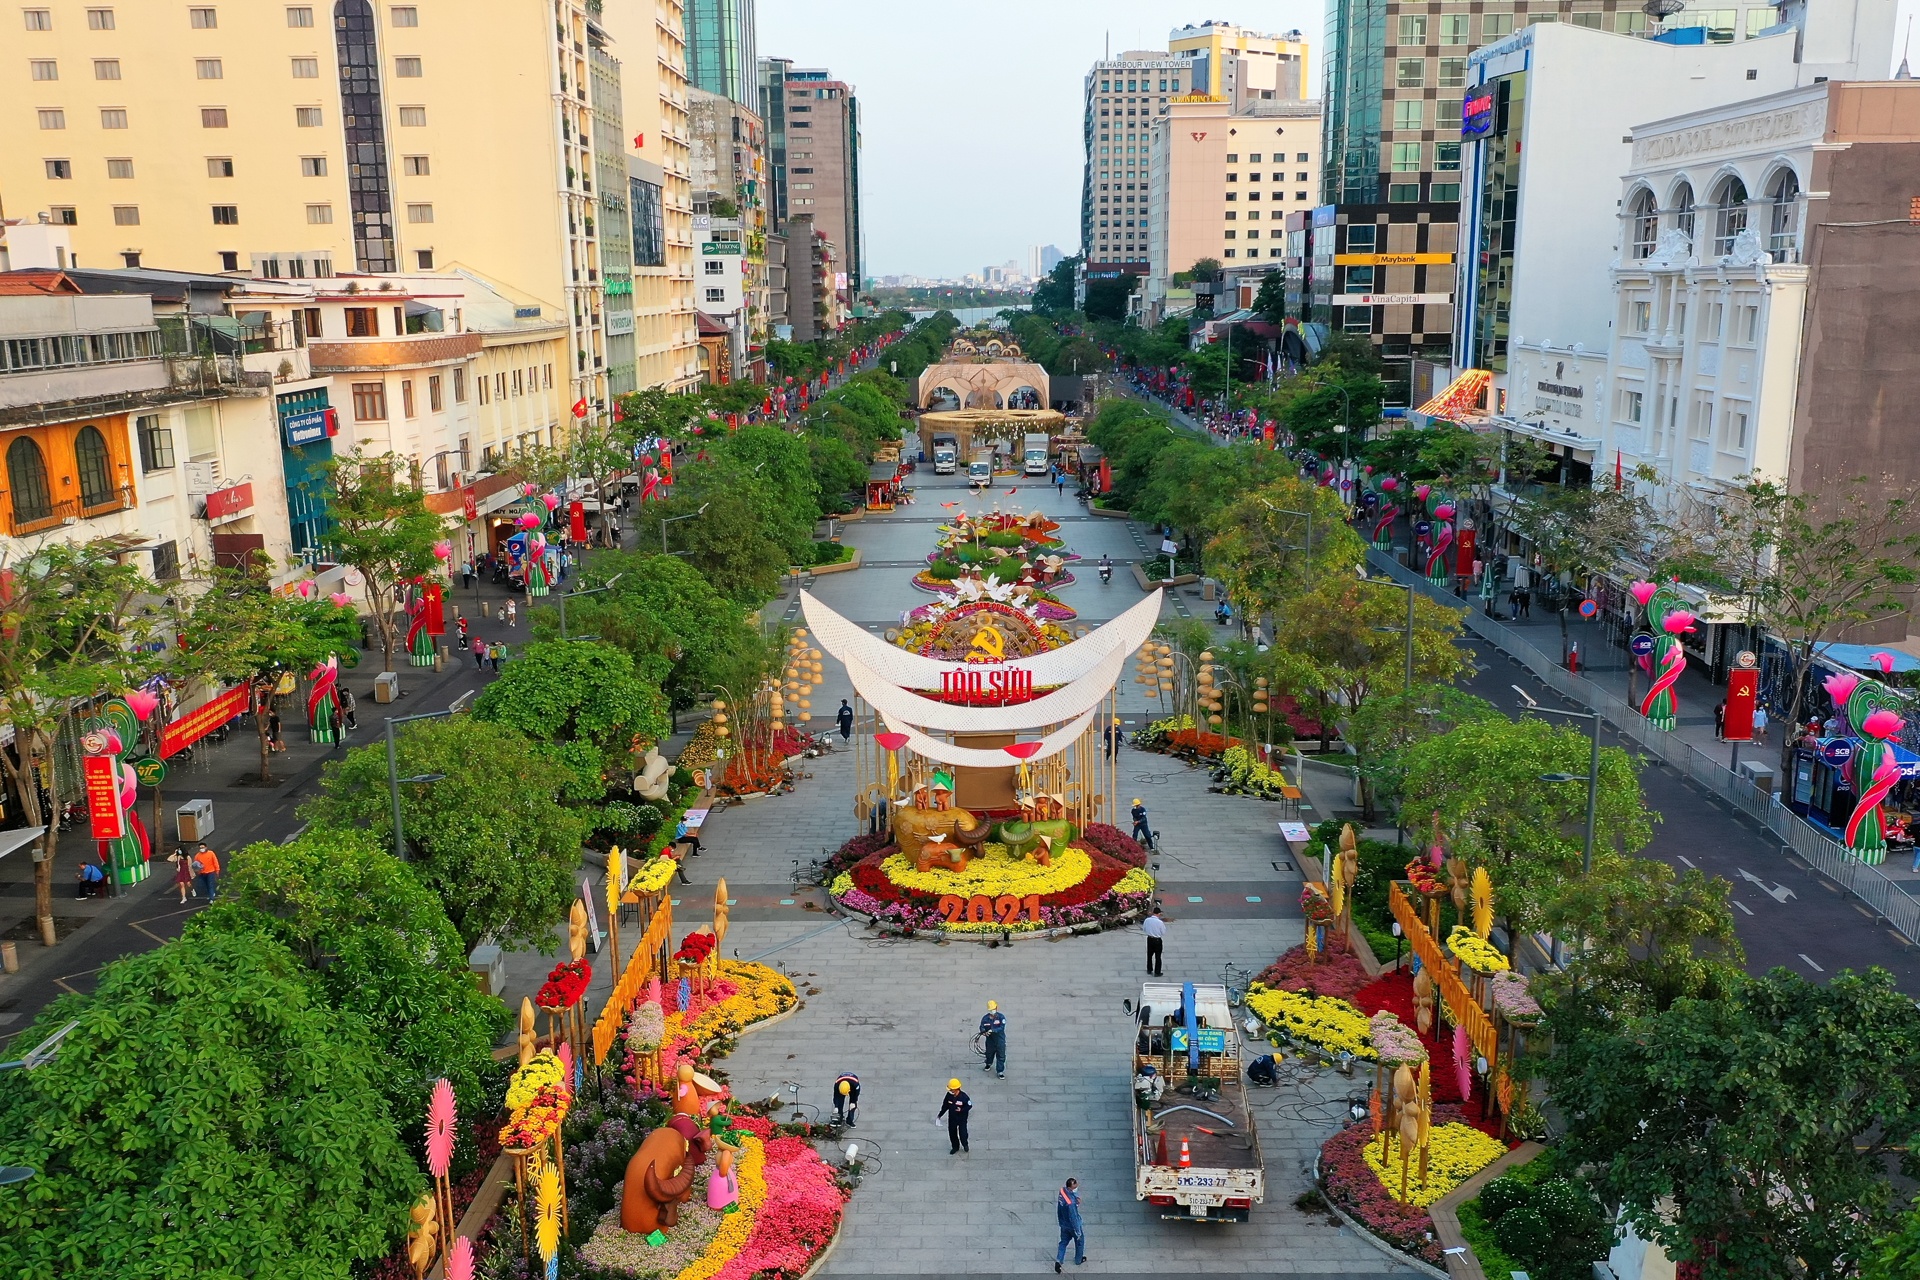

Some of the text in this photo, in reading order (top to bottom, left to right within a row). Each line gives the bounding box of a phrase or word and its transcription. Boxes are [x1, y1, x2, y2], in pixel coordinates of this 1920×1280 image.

[1107, 60, 1191, 69] HARBOUR VIEW TOWER
[1752, 111, 1801, 142] HOTEL
[1380, 255, 1416, 264] Maybank
[1370, 294, 1420, 304] VinaCapital
[992, 602, 1014, 615] QUANG
[1014, 610, 1029, 625] VINH
[940, 665, 1032, 701] TÂN SỬU
[938, 893, 1040, 925] 2021
